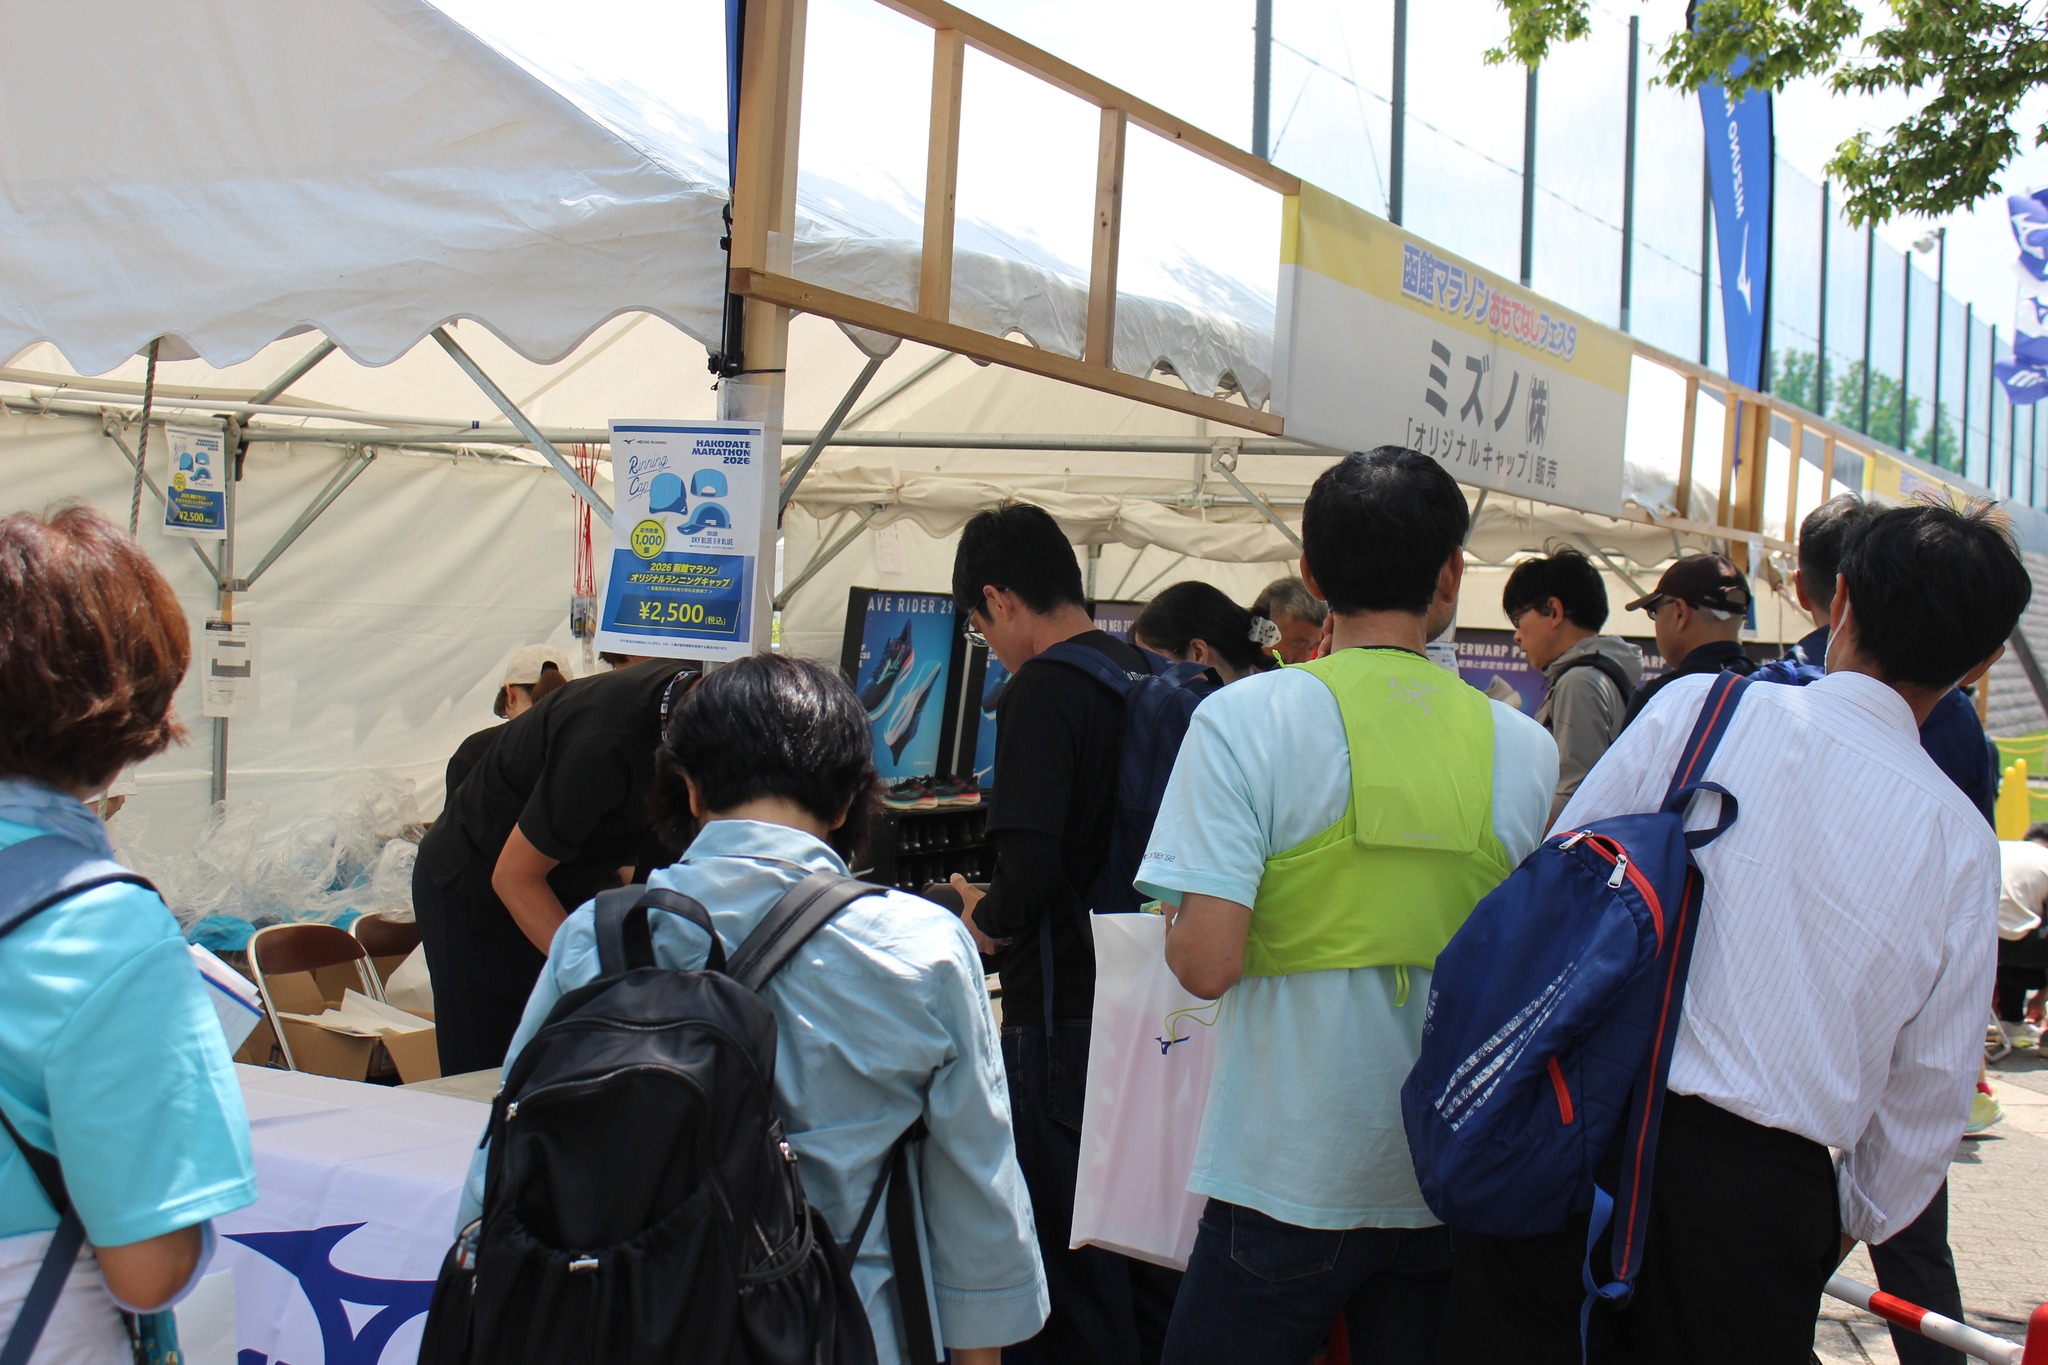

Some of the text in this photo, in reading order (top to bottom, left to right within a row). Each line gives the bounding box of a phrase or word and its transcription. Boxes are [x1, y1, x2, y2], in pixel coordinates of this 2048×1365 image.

[1402, 242, 1577, 357] 函館マラソンおもてなしフェスタ
[696, 439, 751, 449] HAKODATE
[691, 448, 751, 457] MARATHON
[629, 453, 669, 475] Running
[723, 456, 751, 465] 2026
[635, 534, 663, 547] 1,000
[701, 537, 712, 545] BLUE
[721, 538, 734, 546] BLUE
[650, 562, 718, 575] 2026 函館マラソン
[630, 573, 731, 588] オリジナルランニングキャップ
[638, 601, 705, 624] ¥2,500
[897, 598, 935, 613] RIDER
[940, 600, 954, 615] 29
[1142, 851, 1176, 863] onverse
